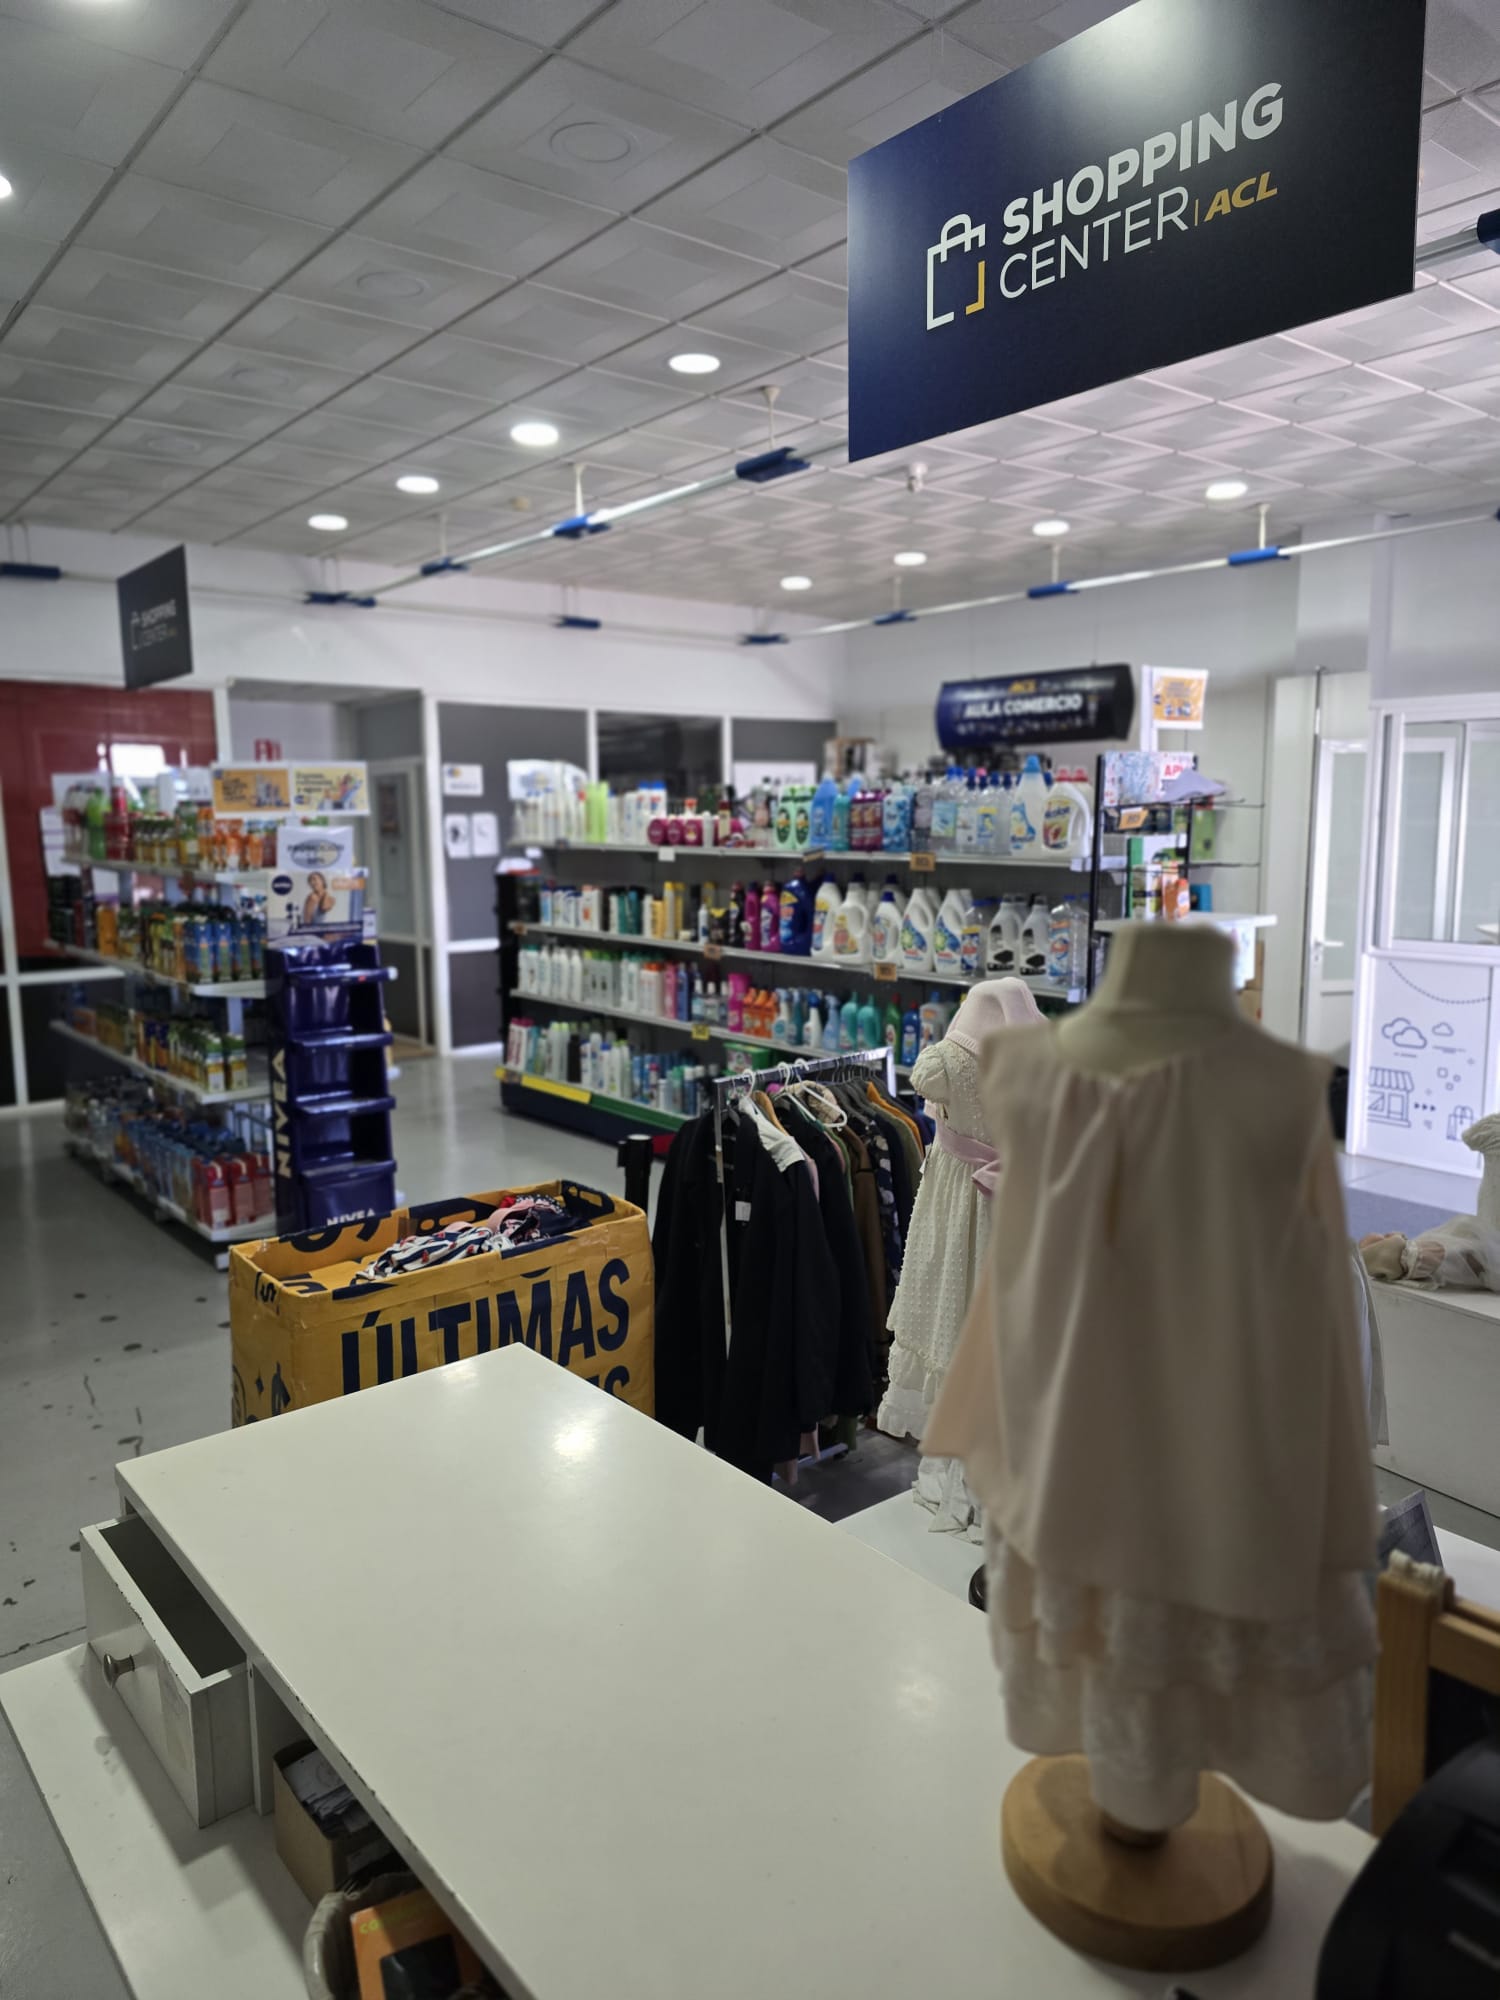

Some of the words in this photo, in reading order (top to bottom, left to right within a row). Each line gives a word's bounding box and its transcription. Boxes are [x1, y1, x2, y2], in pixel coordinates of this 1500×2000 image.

[1002, 82, 1284, 246] SHOPPING
[1000, 186, 1189, 299] CENTER
[1204, 171, 1278, 222] ACL
[271, 1047, 292, 1179] NIVEA
[326, 1208, 376, 1226] NIVEA
[341, 1258, 631, 1396] ÚLTIMAS
